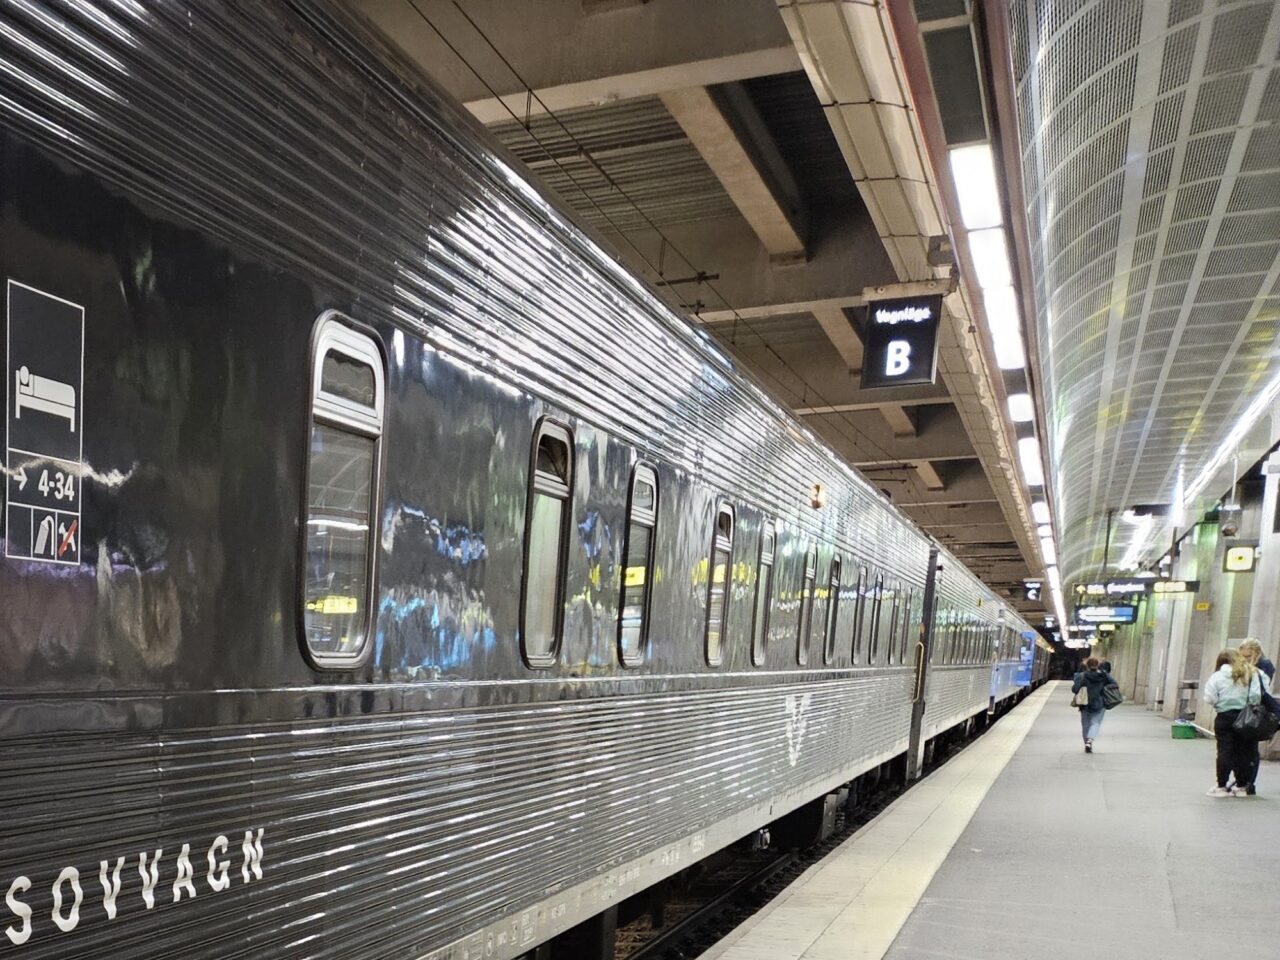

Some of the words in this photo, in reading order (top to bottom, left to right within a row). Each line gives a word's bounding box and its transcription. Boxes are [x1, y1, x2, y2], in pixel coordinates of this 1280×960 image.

[885, 340, 911, 376] B
[38, 469, 75, 501] 4-34
[5, 828, 265, 945] SOVVAGN
